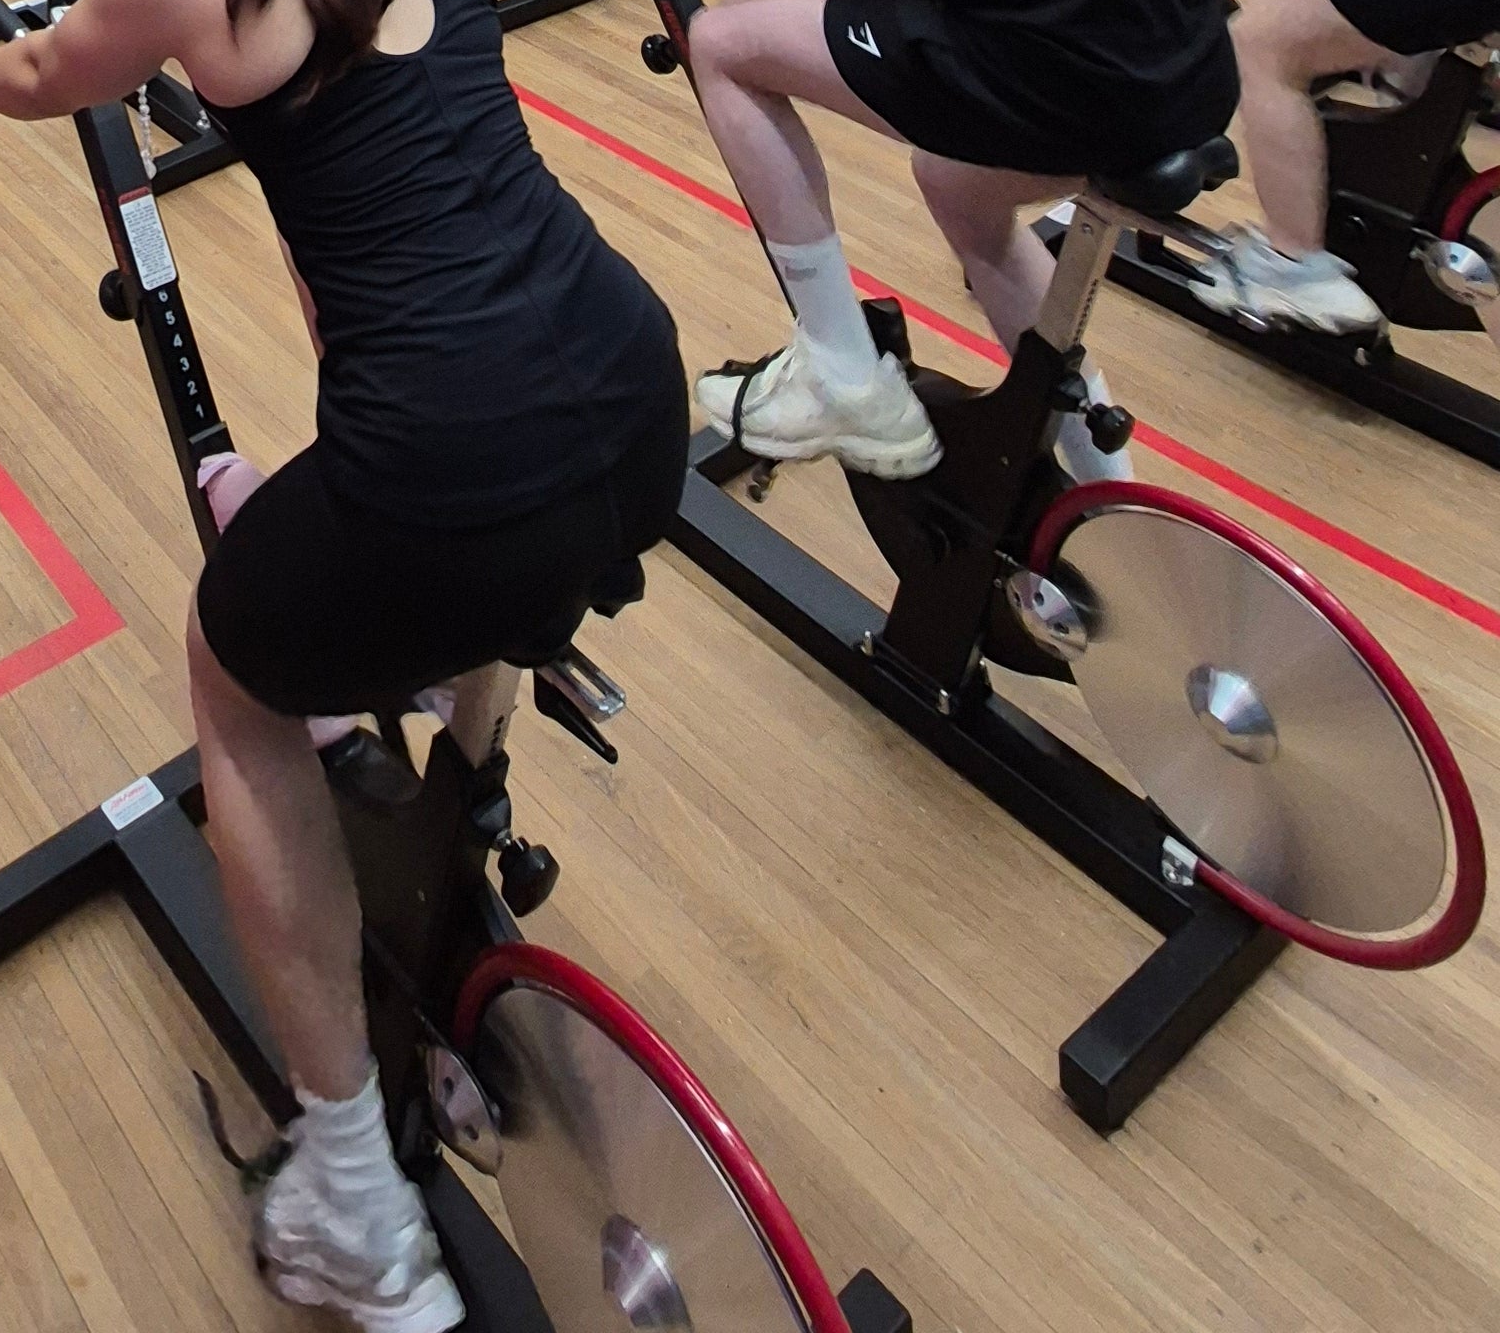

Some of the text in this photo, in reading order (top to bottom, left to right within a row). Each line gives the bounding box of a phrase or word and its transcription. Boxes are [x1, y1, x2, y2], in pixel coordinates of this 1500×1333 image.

[158, 289, 169, 303] 6
[165, 310, 175, 325] 5
[173, 333, 183, 348] 4
[179, 356, 190, 372] 3
[187, 380, 198, 396] 2
[195, 403, 204, 419] 1
